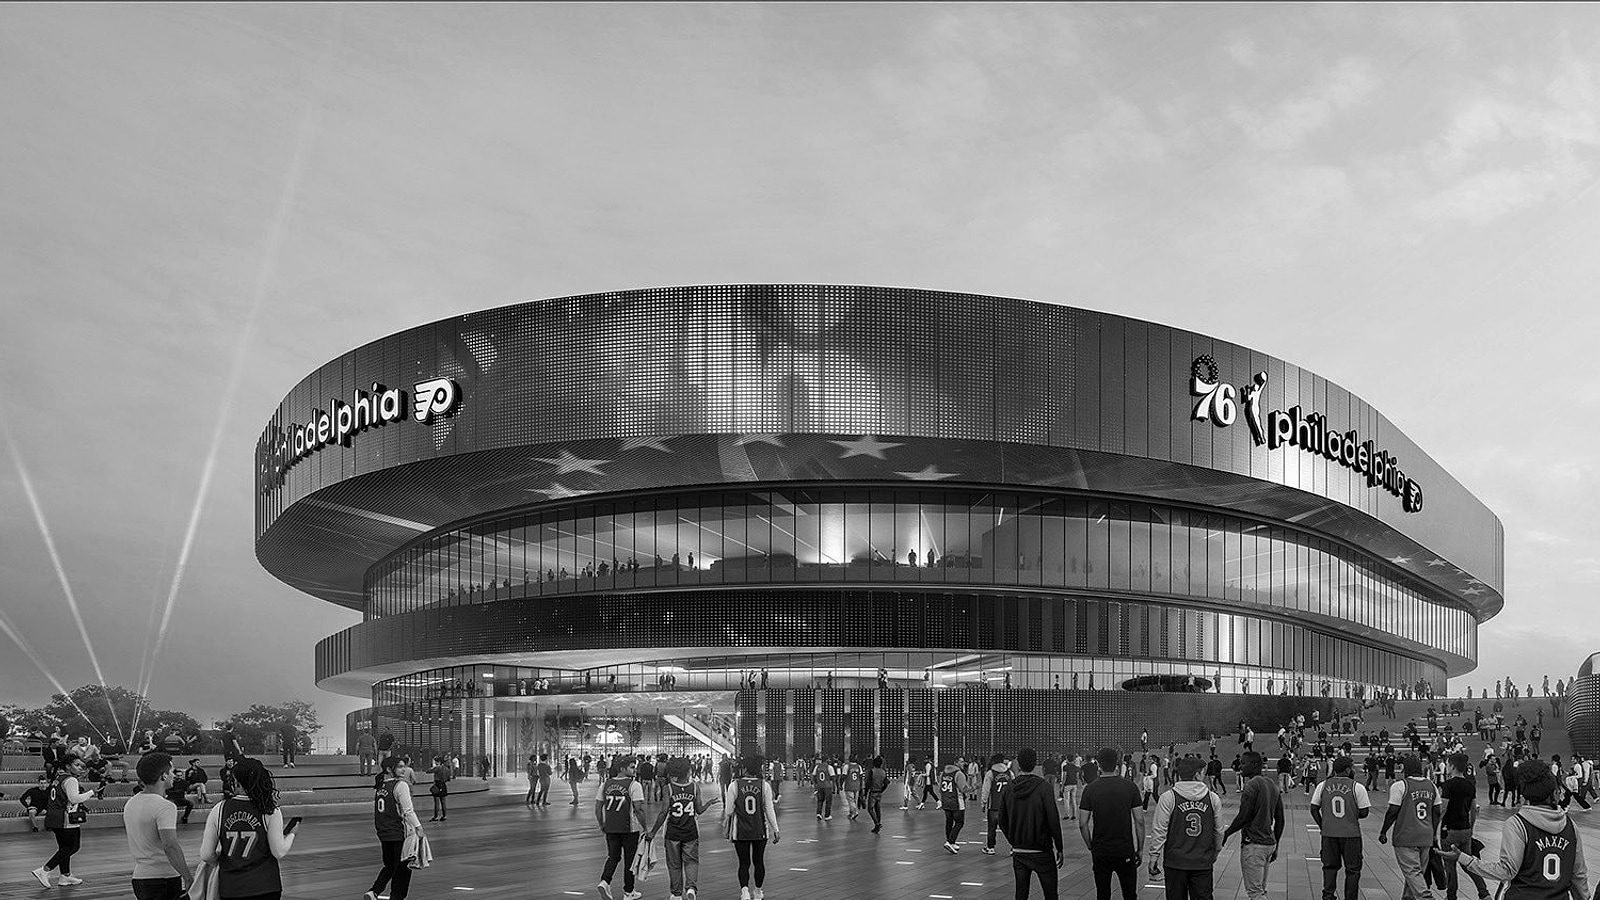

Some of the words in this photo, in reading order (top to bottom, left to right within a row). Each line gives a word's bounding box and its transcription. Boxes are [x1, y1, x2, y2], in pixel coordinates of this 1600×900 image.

[1194, 376, 1237, 426] 76
[1274, 405, 1406, 494] philadelphia
[941, 780, 954, 793] 34
[377, 797, 386, 813] 0
[605, 795, 626, 812] 77
[671, 801, 695, 818] 34
[745, 795, 757, 815] 0
[1177, 800, 1210, 813] IVERSON
[1331, 795, 1346, 818] 0
[1415, 801, 1428, 820] 6
[1185, 812, 1203, 837] 3
[226, 831, 257, 858] 77
[1535, 835, 1570, 852] MAXEY
[1542, 853, 1561, 881] 0
